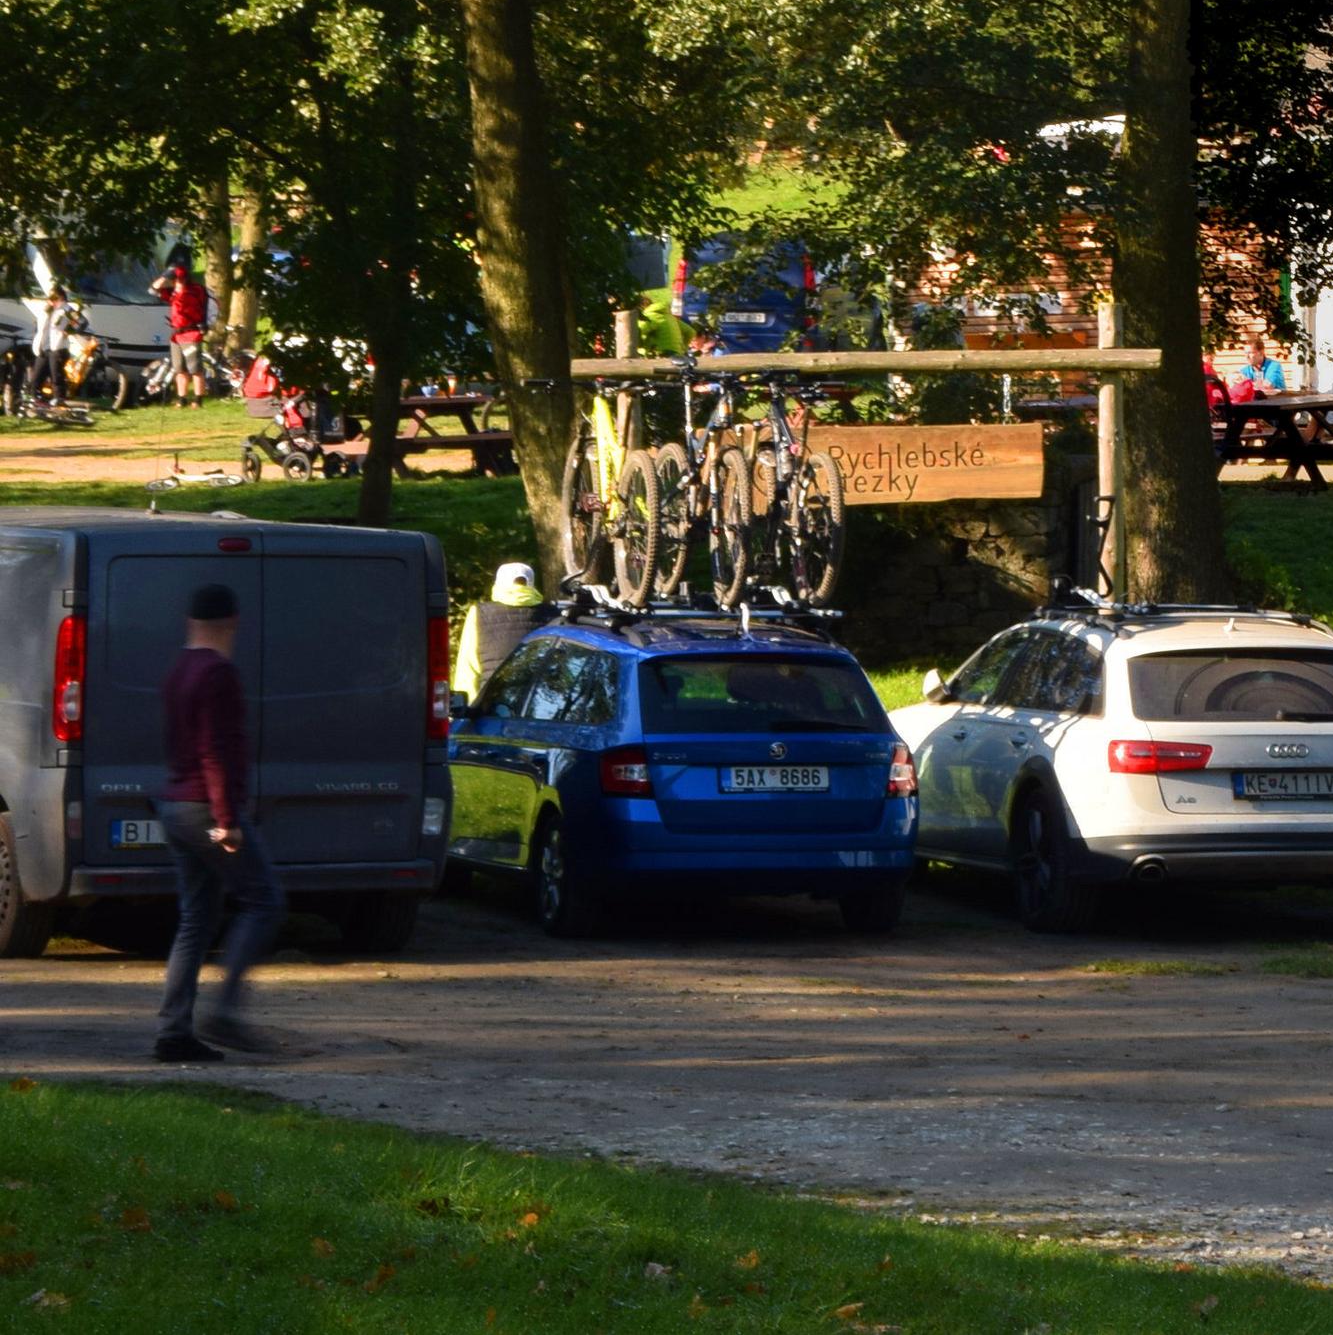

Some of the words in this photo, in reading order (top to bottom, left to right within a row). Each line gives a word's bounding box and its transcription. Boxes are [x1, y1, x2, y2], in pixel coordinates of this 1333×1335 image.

[827, 441, 985, 478] Rychlebské
[828, 469, 919, 501] tezky
[734, 768, 767, 787] 5AX
[779, 768, 821, 787] 8686
[1245, 774, 1269, 794] KE
